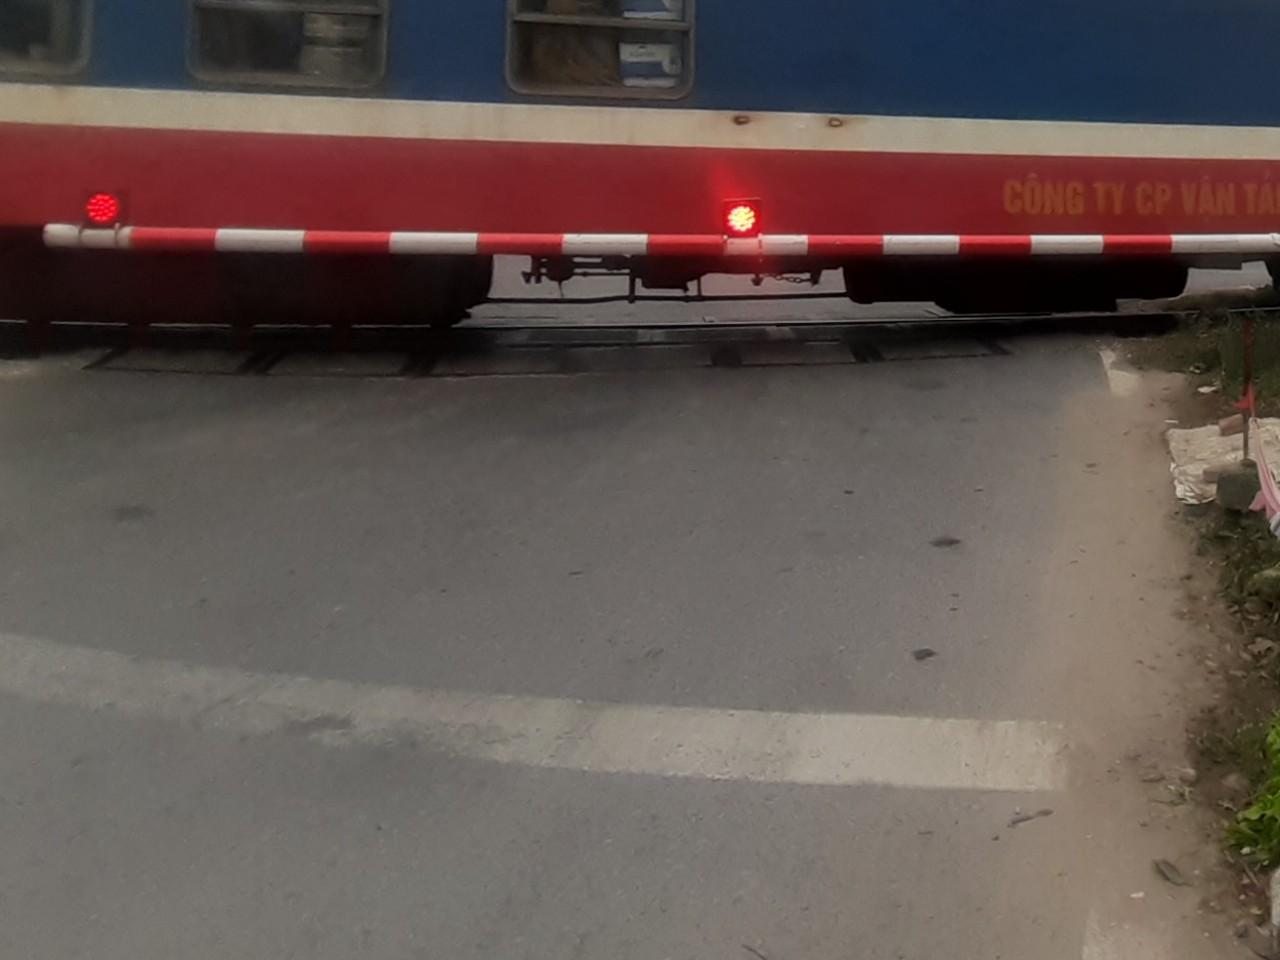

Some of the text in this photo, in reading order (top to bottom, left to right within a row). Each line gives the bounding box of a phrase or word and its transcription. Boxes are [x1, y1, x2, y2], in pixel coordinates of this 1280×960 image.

[1003, 172, 1086, 216] CÔNG
[1093, 181, 1127, 216] TY
[1135, 181, 1173, 216] CP
